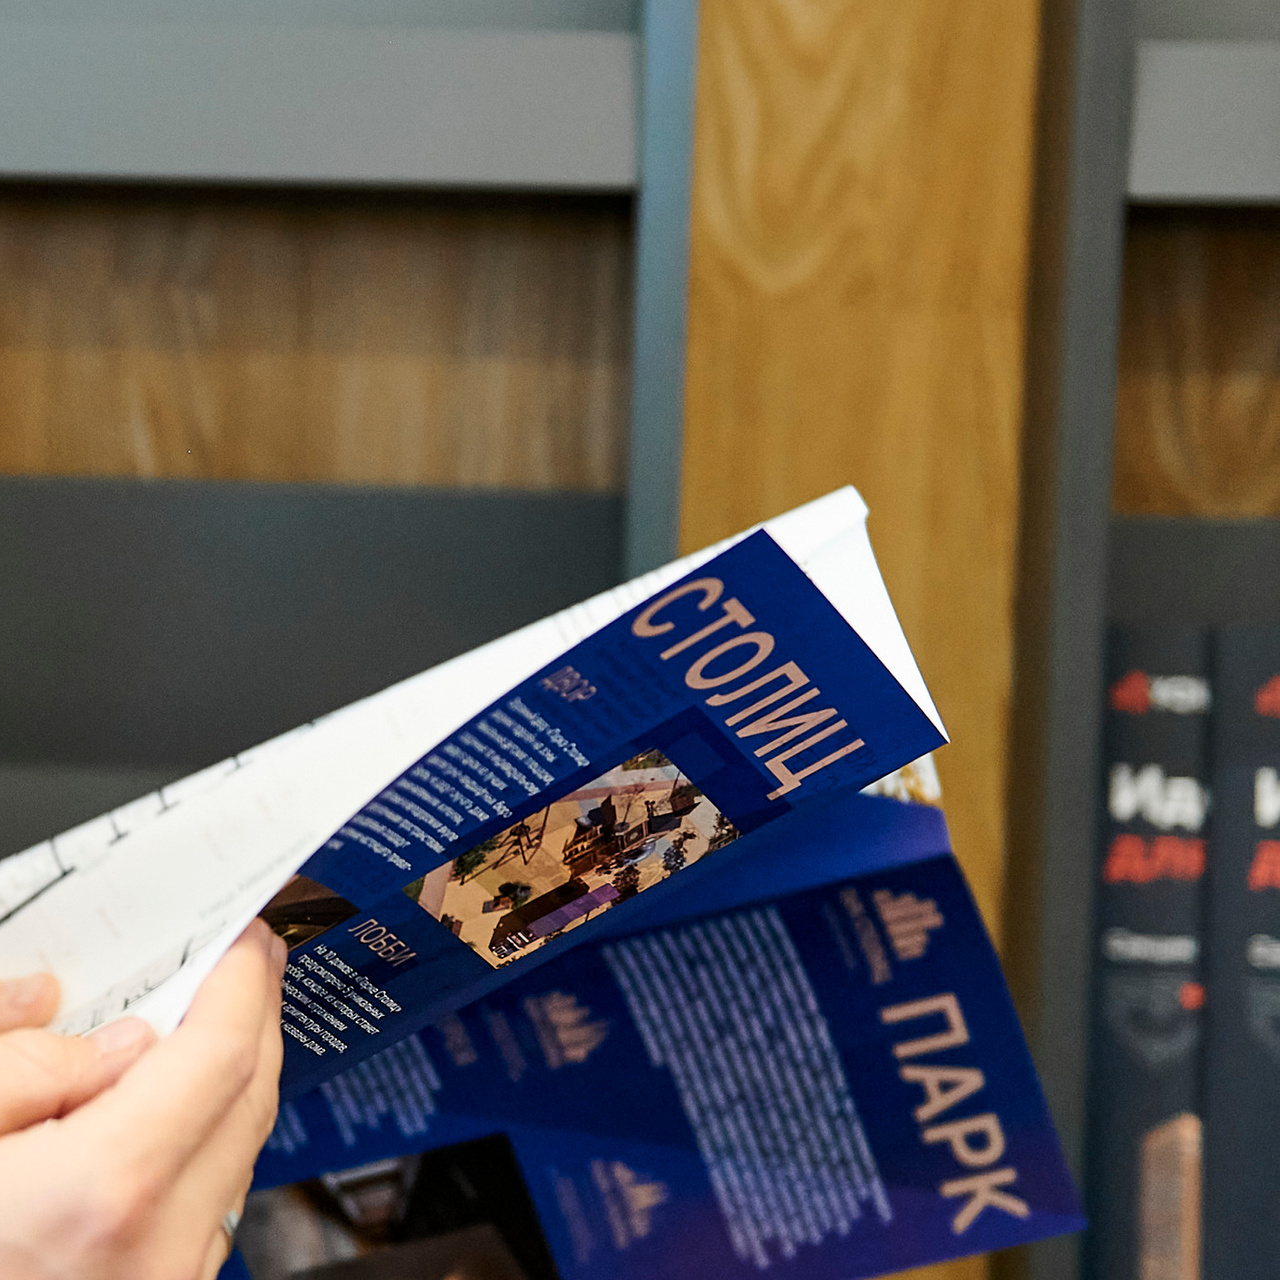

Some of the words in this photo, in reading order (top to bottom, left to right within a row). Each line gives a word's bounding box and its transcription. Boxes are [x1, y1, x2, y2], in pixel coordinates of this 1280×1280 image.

[632, 577, 865, 801] СТОЛИЦ
[348, 919, 417, 967] ЛОББИ
[880, 993, 1030, 1234] ПАРК
